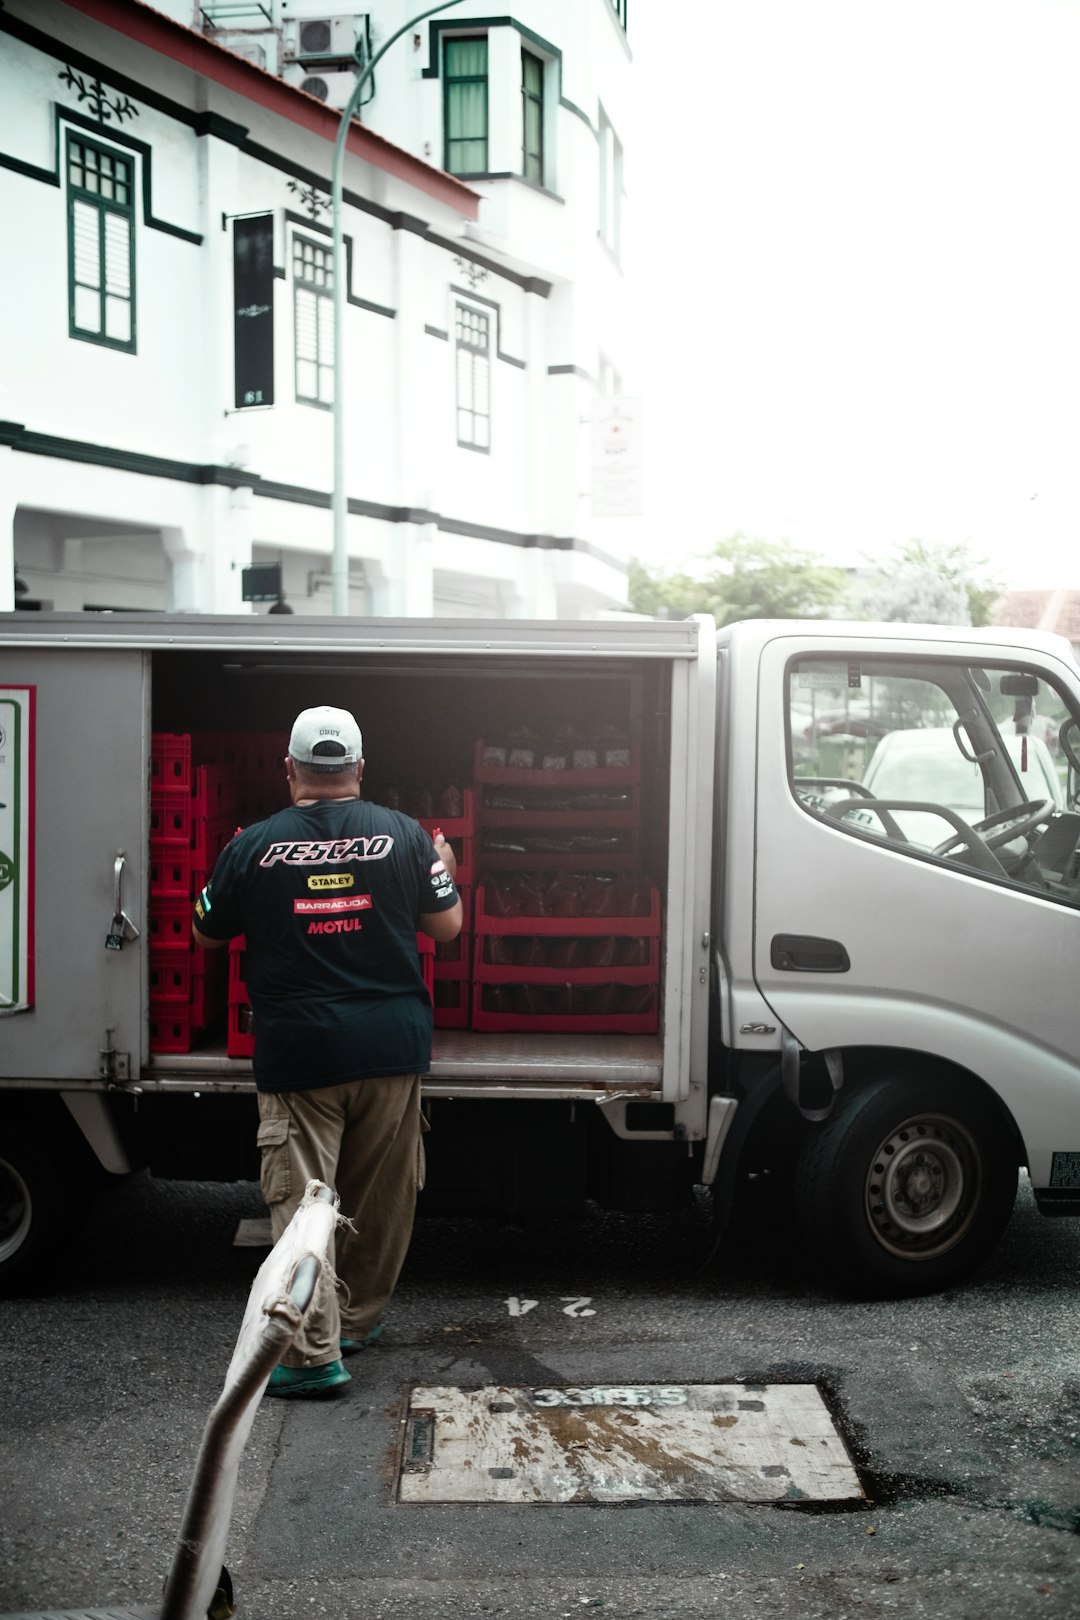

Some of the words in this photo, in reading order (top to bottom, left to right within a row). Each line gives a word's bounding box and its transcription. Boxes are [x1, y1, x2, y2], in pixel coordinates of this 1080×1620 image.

[311, 876, 351, 887] STANLEY
[296, 898, 370, 910] BARRACUDA
[307, 918, 362, 935] MOTUL
